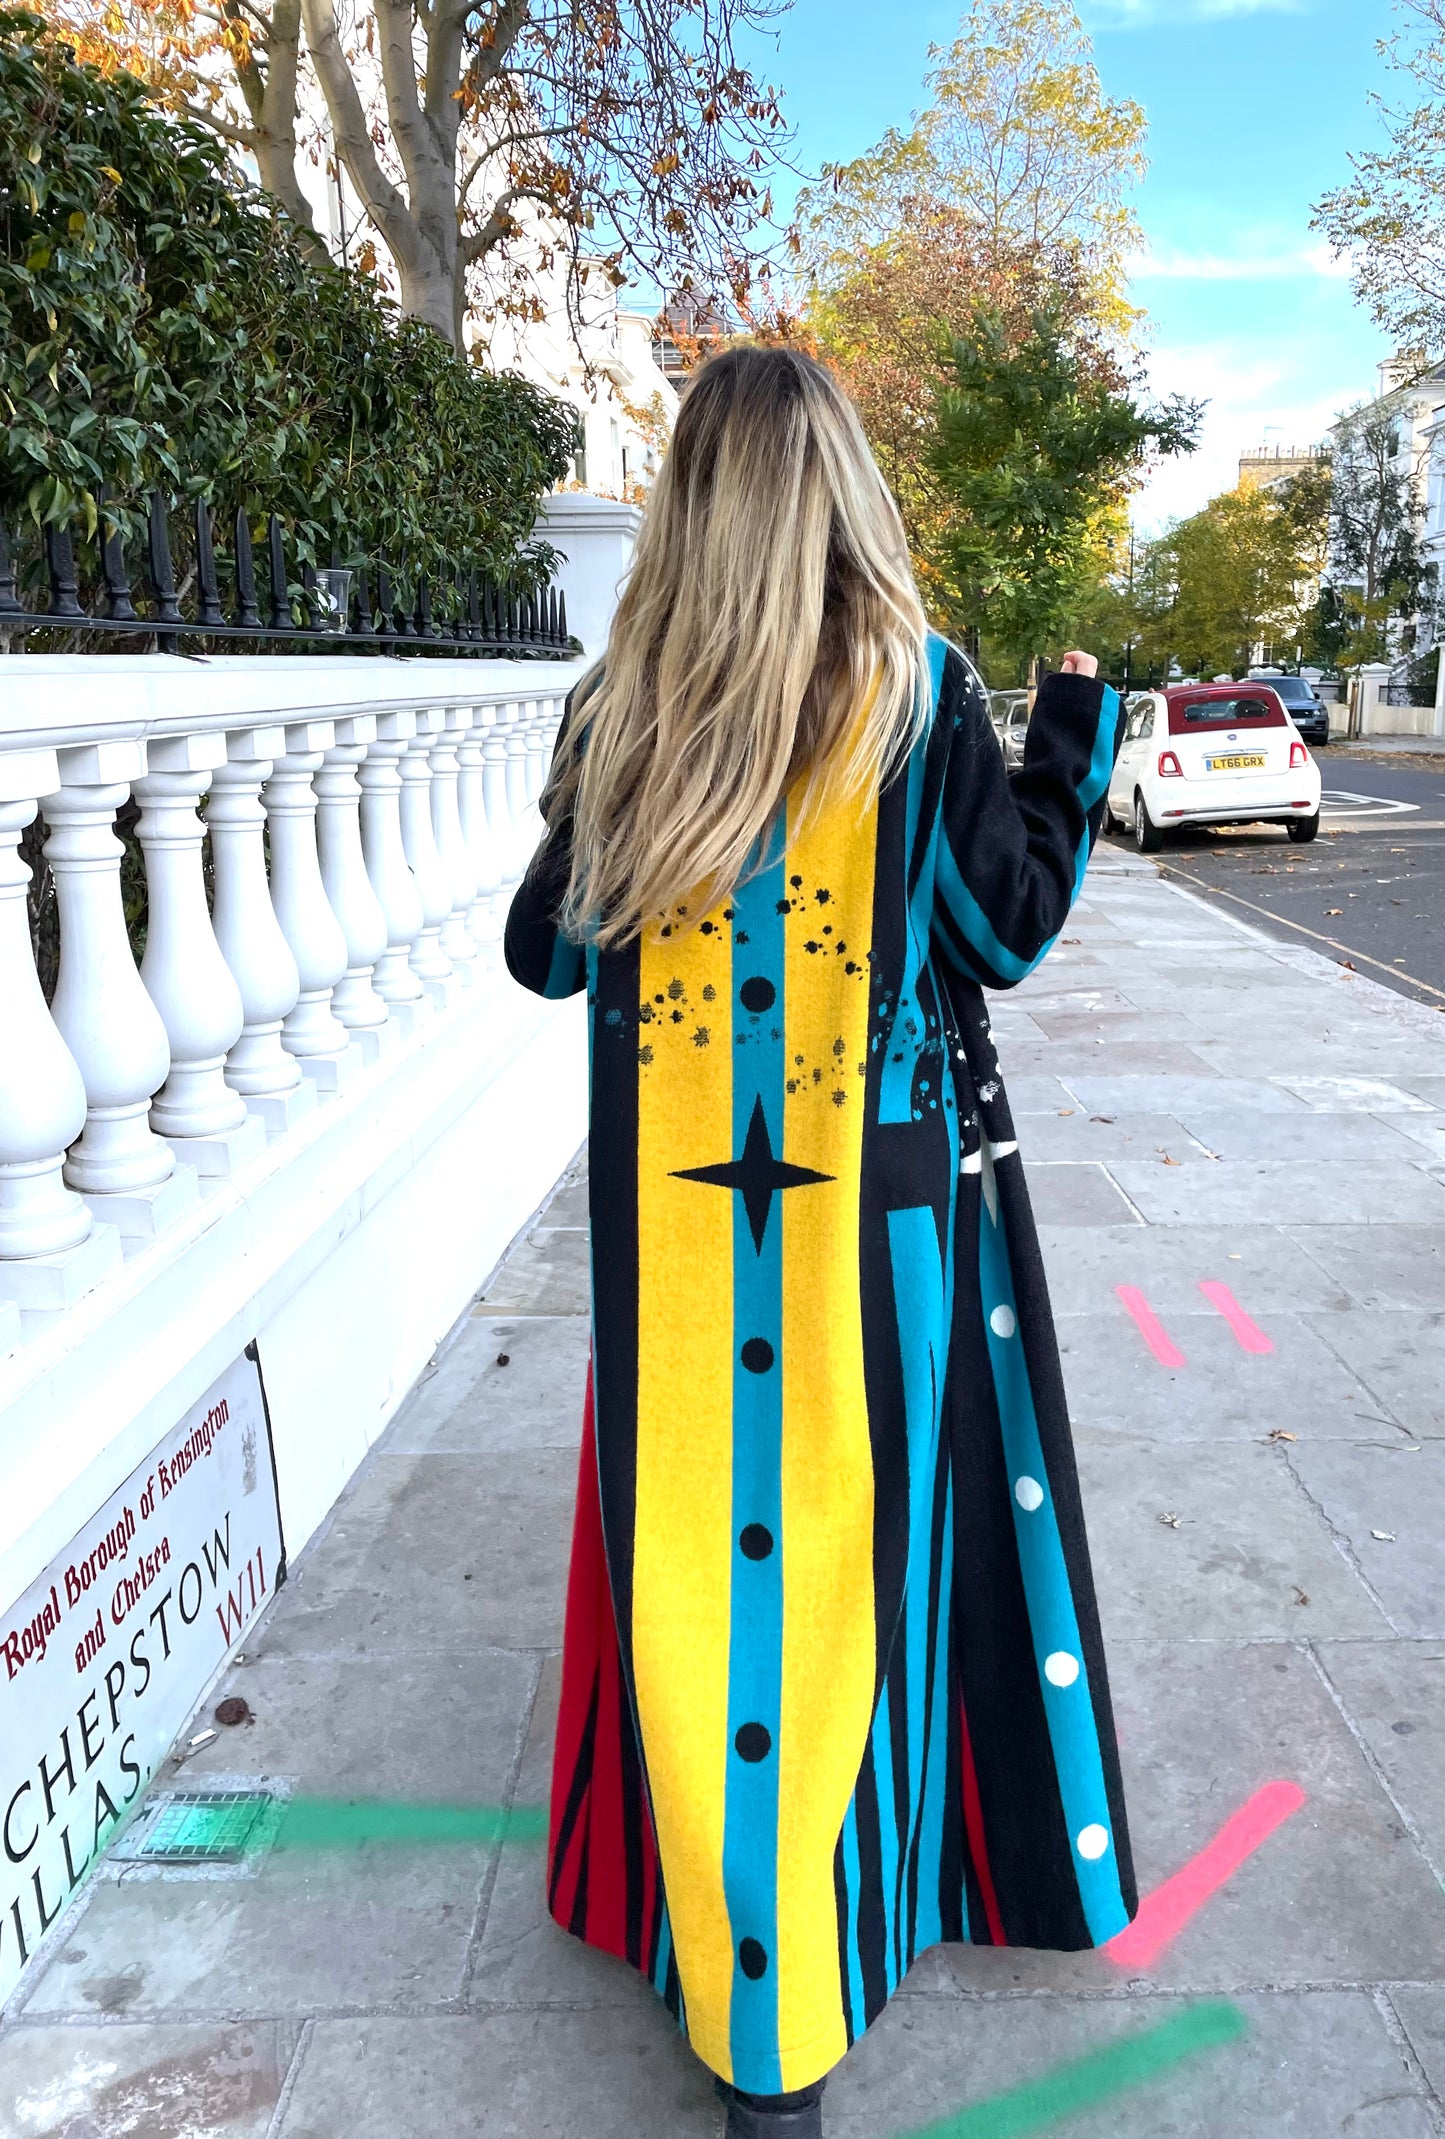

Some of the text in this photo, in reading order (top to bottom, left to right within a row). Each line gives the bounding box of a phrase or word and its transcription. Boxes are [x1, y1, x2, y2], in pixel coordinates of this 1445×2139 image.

[1212, 756, 1264, 769] LT66 GRX
[0, 1398, 230, 1682] Royal Borough of Kensington
[75, 1536, 171, 1674] and Chelsea
[3, 1510, 231, 1864] CHEPSTOW
[0, 1732, 151, 1969] ILLAS.
